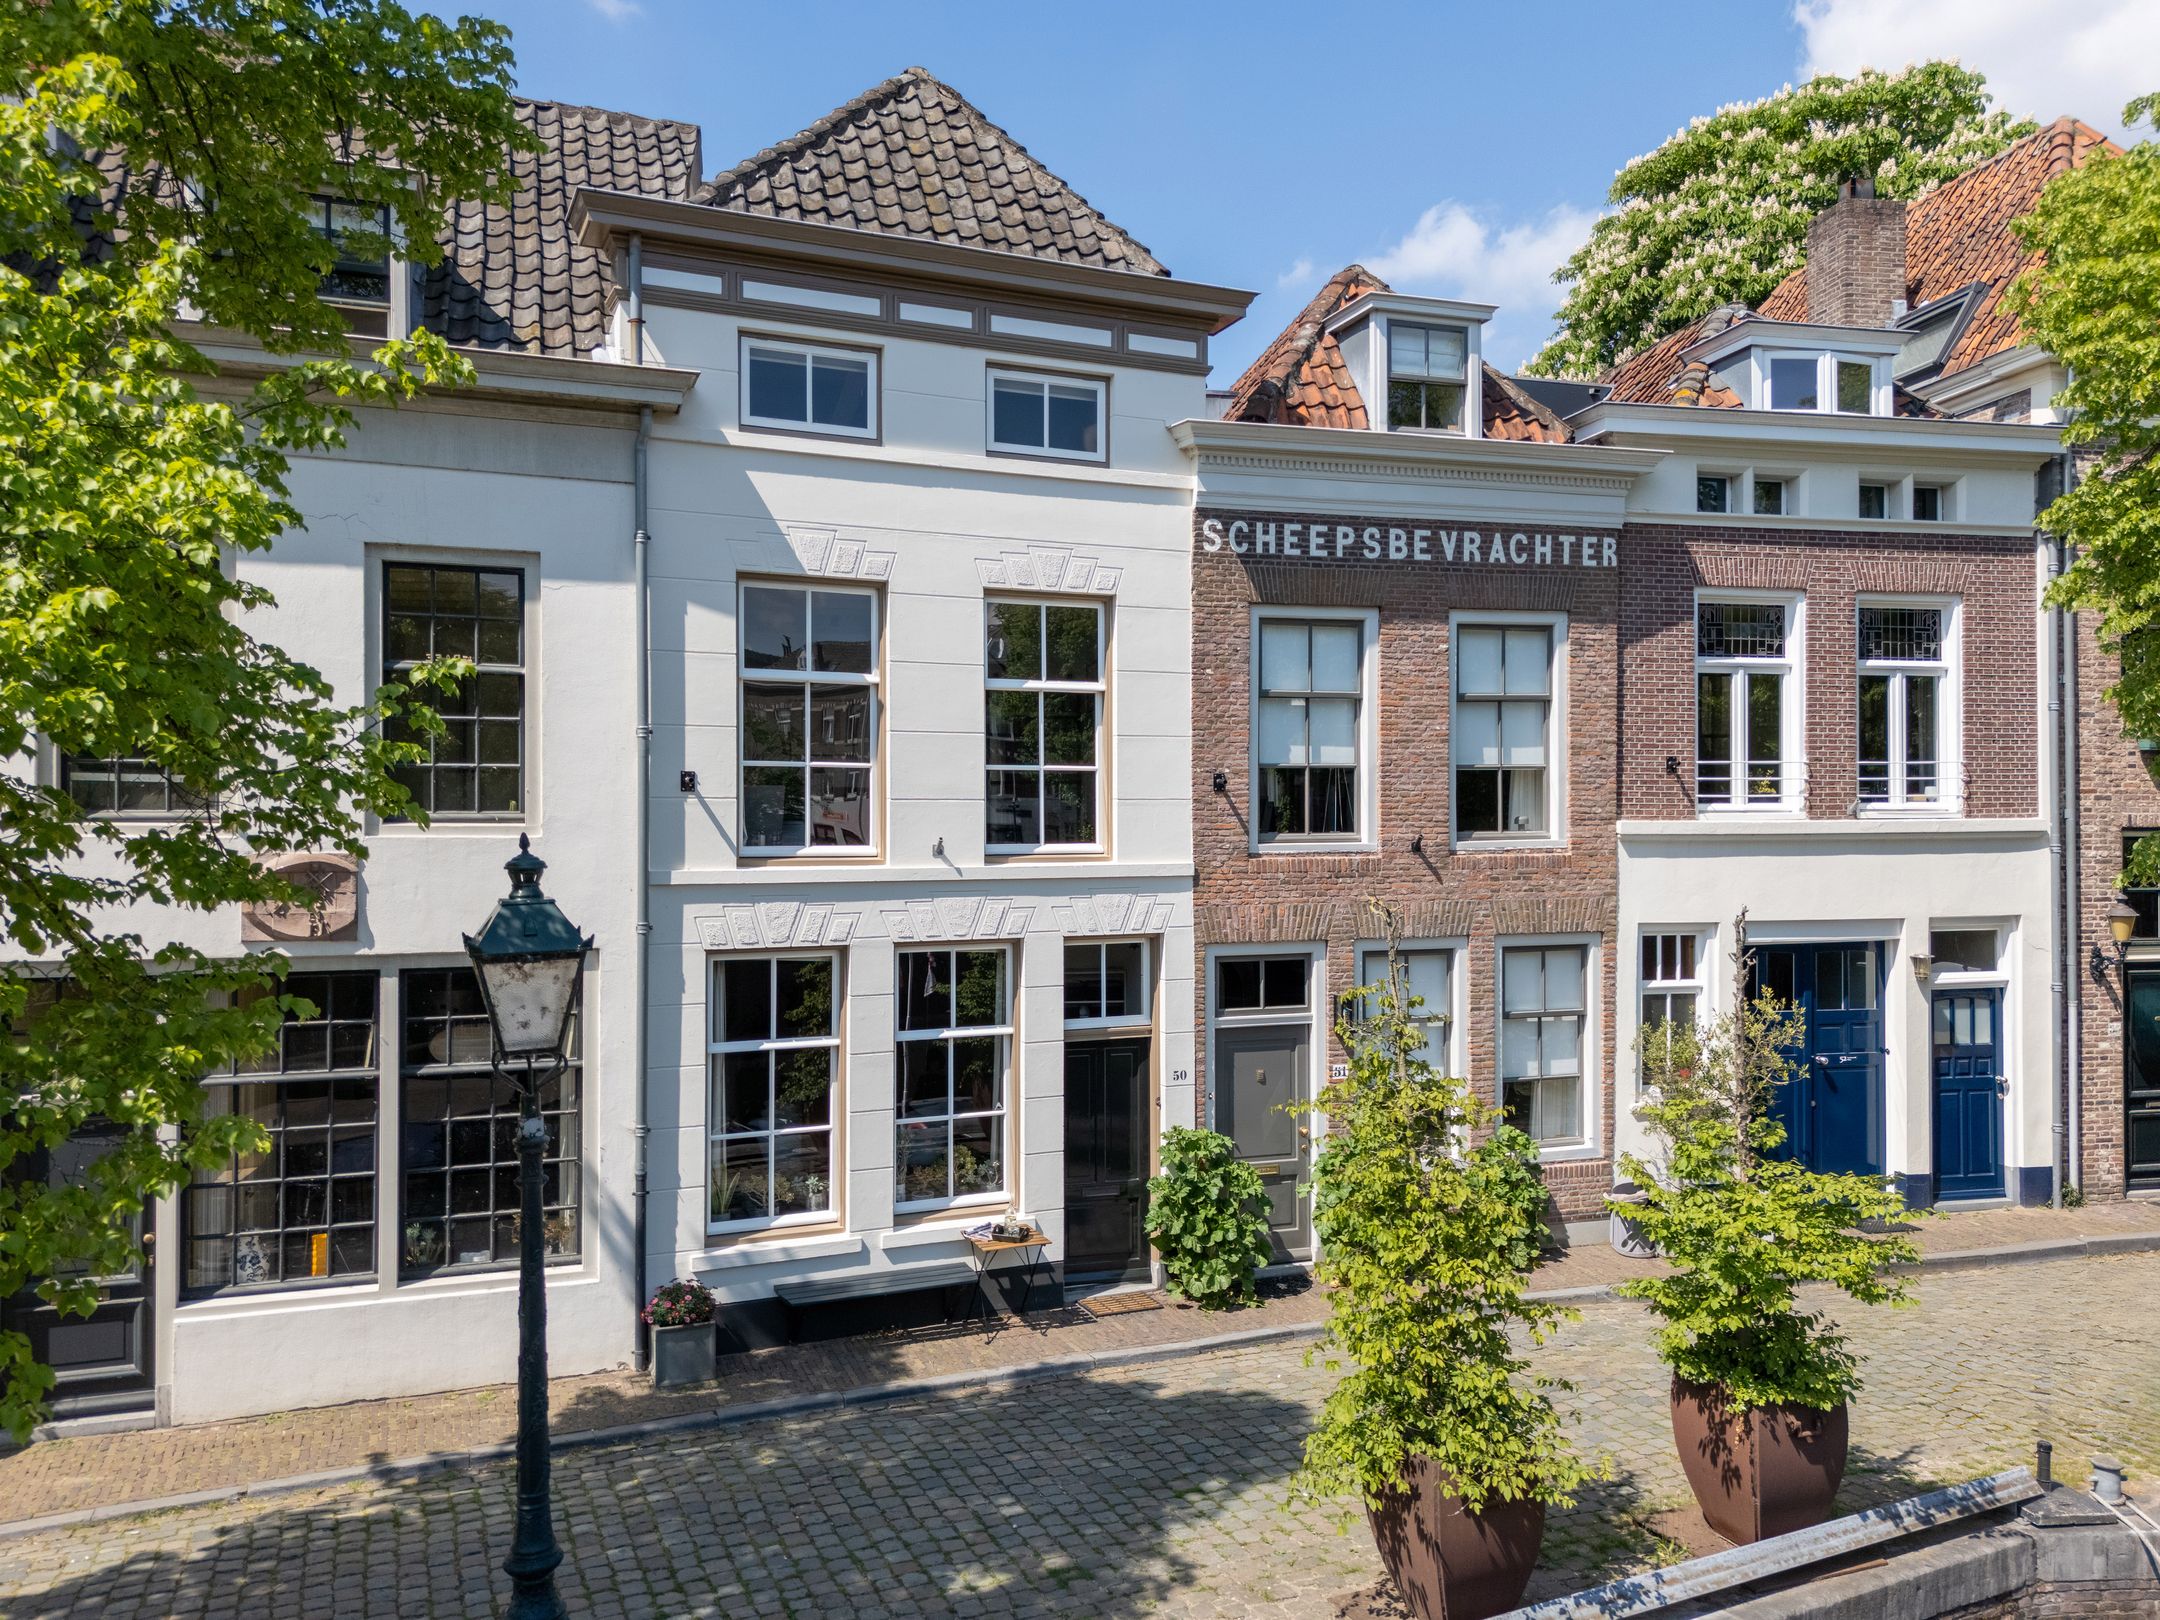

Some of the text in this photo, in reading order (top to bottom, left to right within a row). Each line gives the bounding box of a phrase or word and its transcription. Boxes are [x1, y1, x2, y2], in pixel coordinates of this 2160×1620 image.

[1202, 518, 1617, 567] SCHEEPSBEVRACHTER
[1173, 1070, 1187, 1081] 50
[1334, 1066, 1347, 1077] 51
